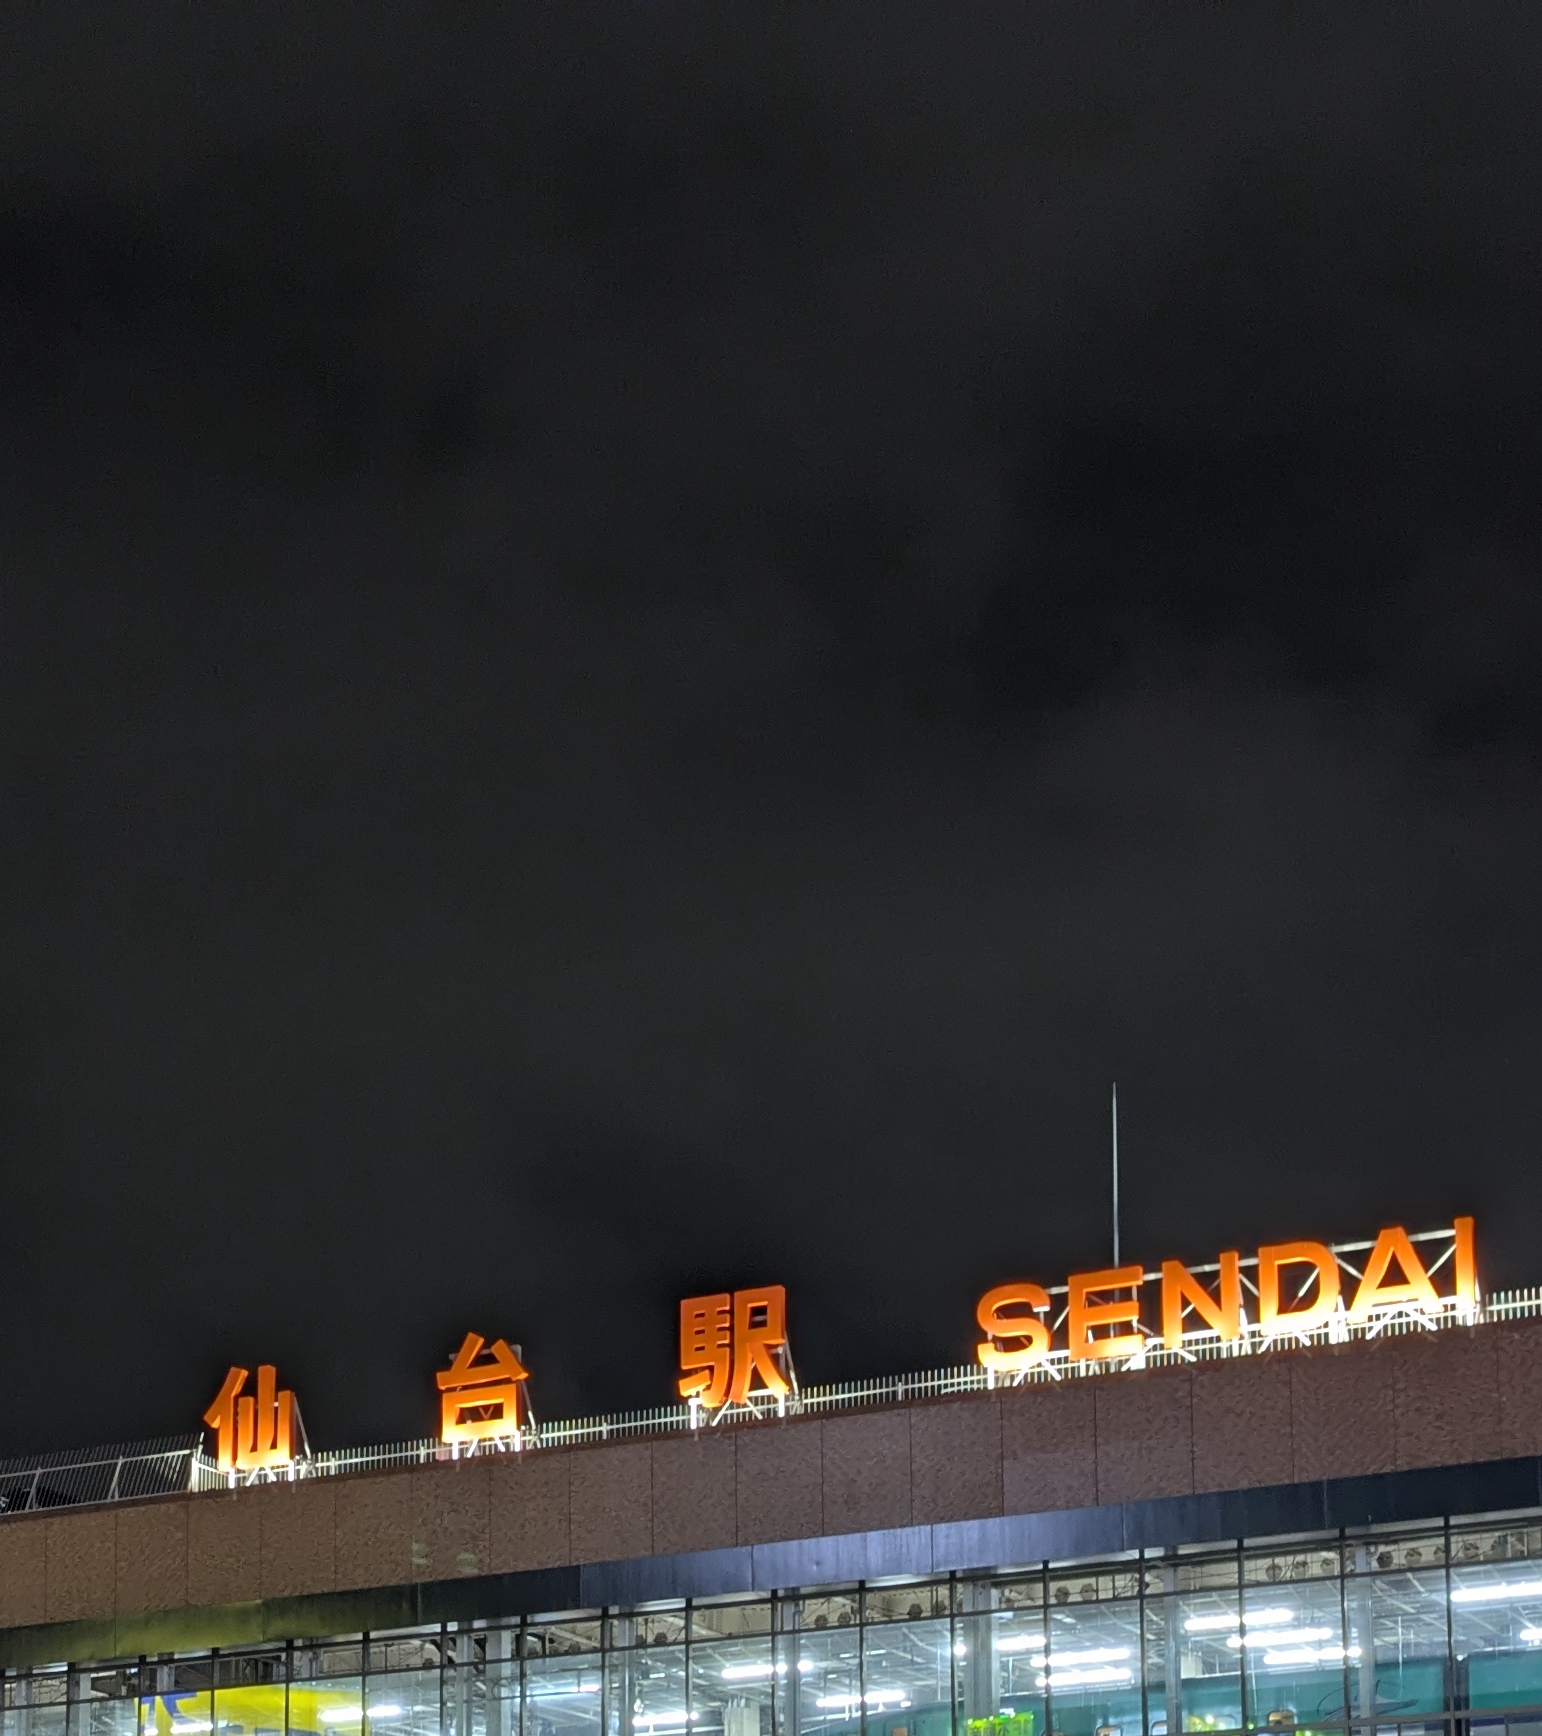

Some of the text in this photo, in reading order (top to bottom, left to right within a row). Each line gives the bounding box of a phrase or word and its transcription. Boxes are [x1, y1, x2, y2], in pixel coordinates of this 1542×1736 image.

[204, 1285, 790, 1472] 仙台駅
[976, 1216, 1478, 1372] SENDAI
